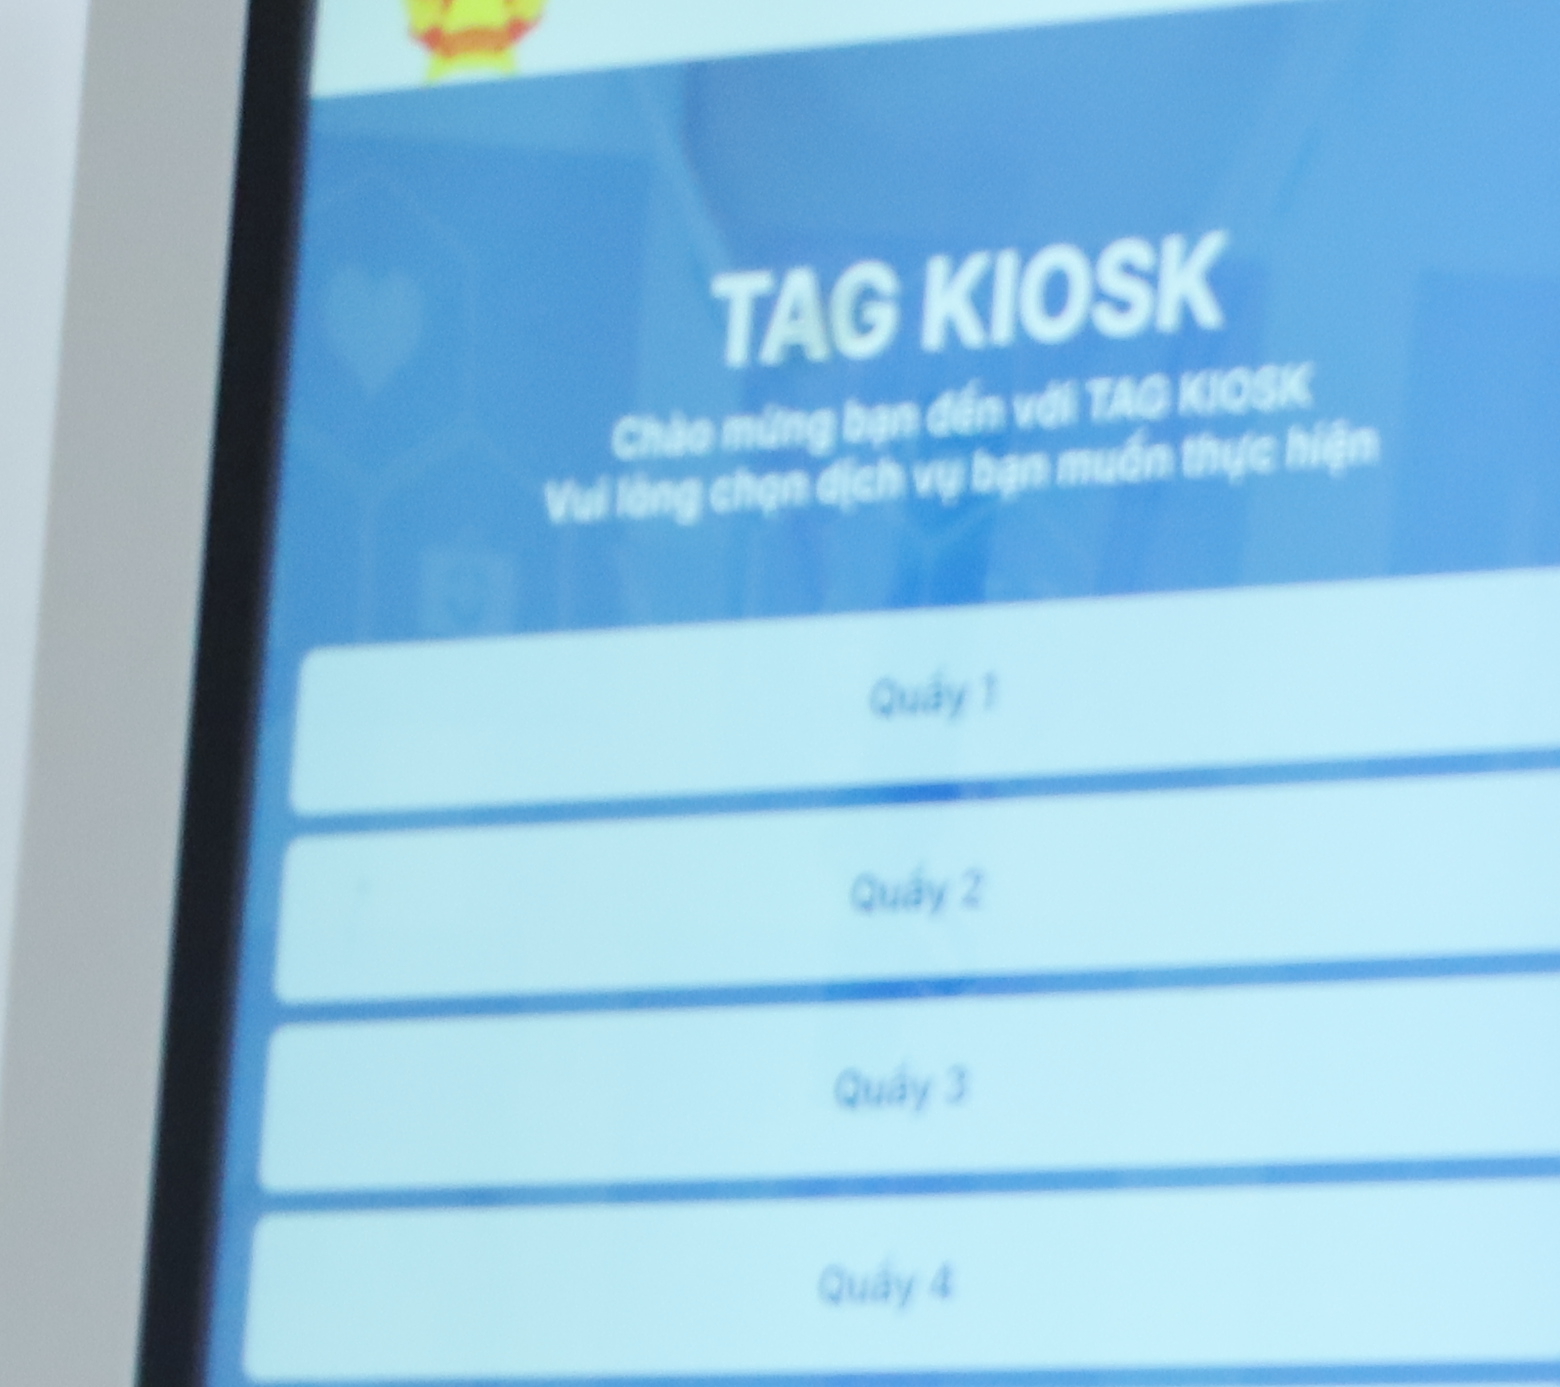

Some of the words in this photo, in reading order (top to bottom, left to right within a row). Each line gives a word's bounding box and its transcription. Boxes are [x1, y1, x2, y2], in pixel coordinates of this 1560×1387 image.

[709, 259, 901, 369] TAG
[919, 228, 1231, 354] KIOSK
[1085, 370, 1170, 424] TAG
[1177, 360, 1315, 417] KIOSK
[979, 669, 1000, 711] 1
[960, 866, 987, 912] 2
[944, 1062, 971, 1105] 3
[928, 1259, 957, 1303] 4
